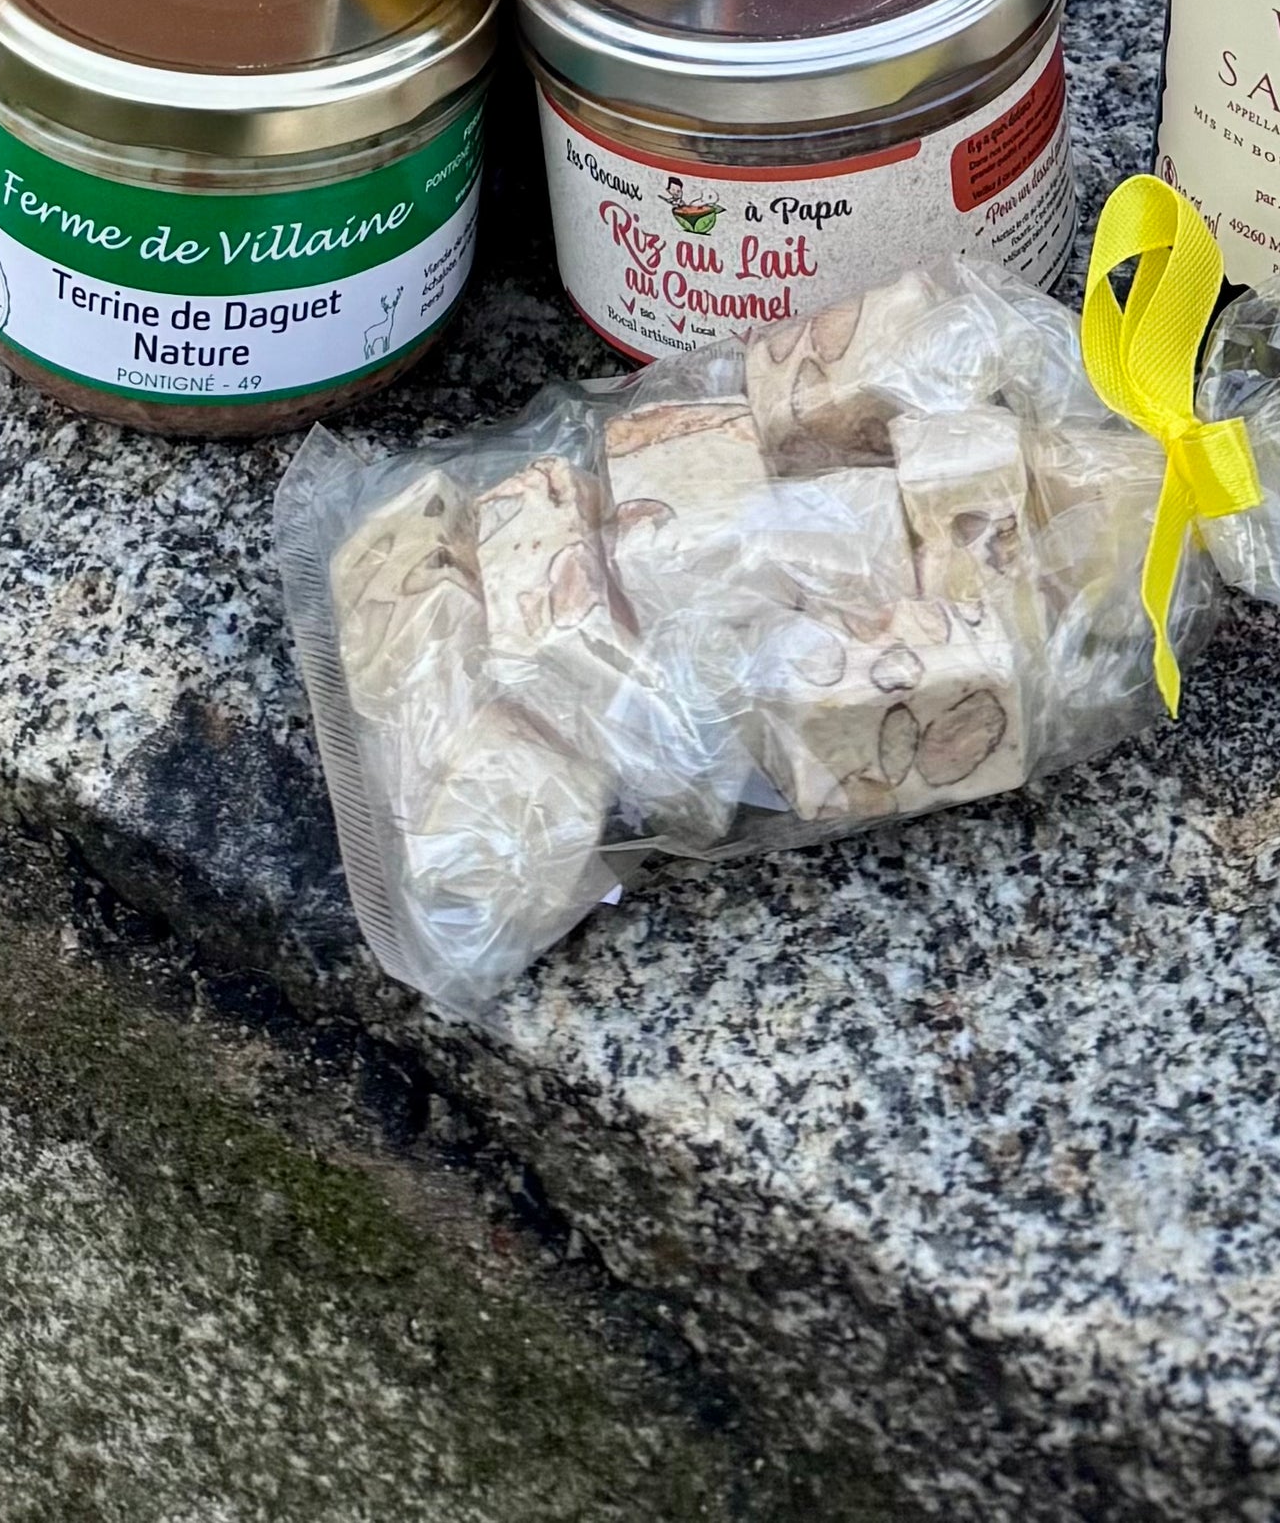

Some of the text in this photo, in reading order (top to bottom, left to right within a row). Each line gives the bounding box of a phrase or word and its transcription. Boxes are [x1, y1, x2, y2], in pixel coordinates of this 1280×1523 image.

[1193, 104, 1218, 131] MIS
[1223, 128, 1244, 147] EN
[585, 153, 643, 201] Bocaux
[1255, 189, 1276, 207] par
[3, 169, 132, 250] Ferme
[140, 225, 210, 265] de
[219, 200, 415, 267] Villaine
[745, 197, 852, 230] à Papa
[986, 195, 1016, 225] Pour
[599, 200, 818, 280] Riz au Lait
[1229, 218, 1266, 246] 49260
[51, 268, 343, 334] Terrine de Daguet
[625, 267, 792, 321] au Caramel
[132, 332, 250, 367] Nature
[607, 305, 697, 352] Bocal artisanal
[117, 366, 216, 391] PONTIGNÉ
[237, 376, 263, 391] 49
